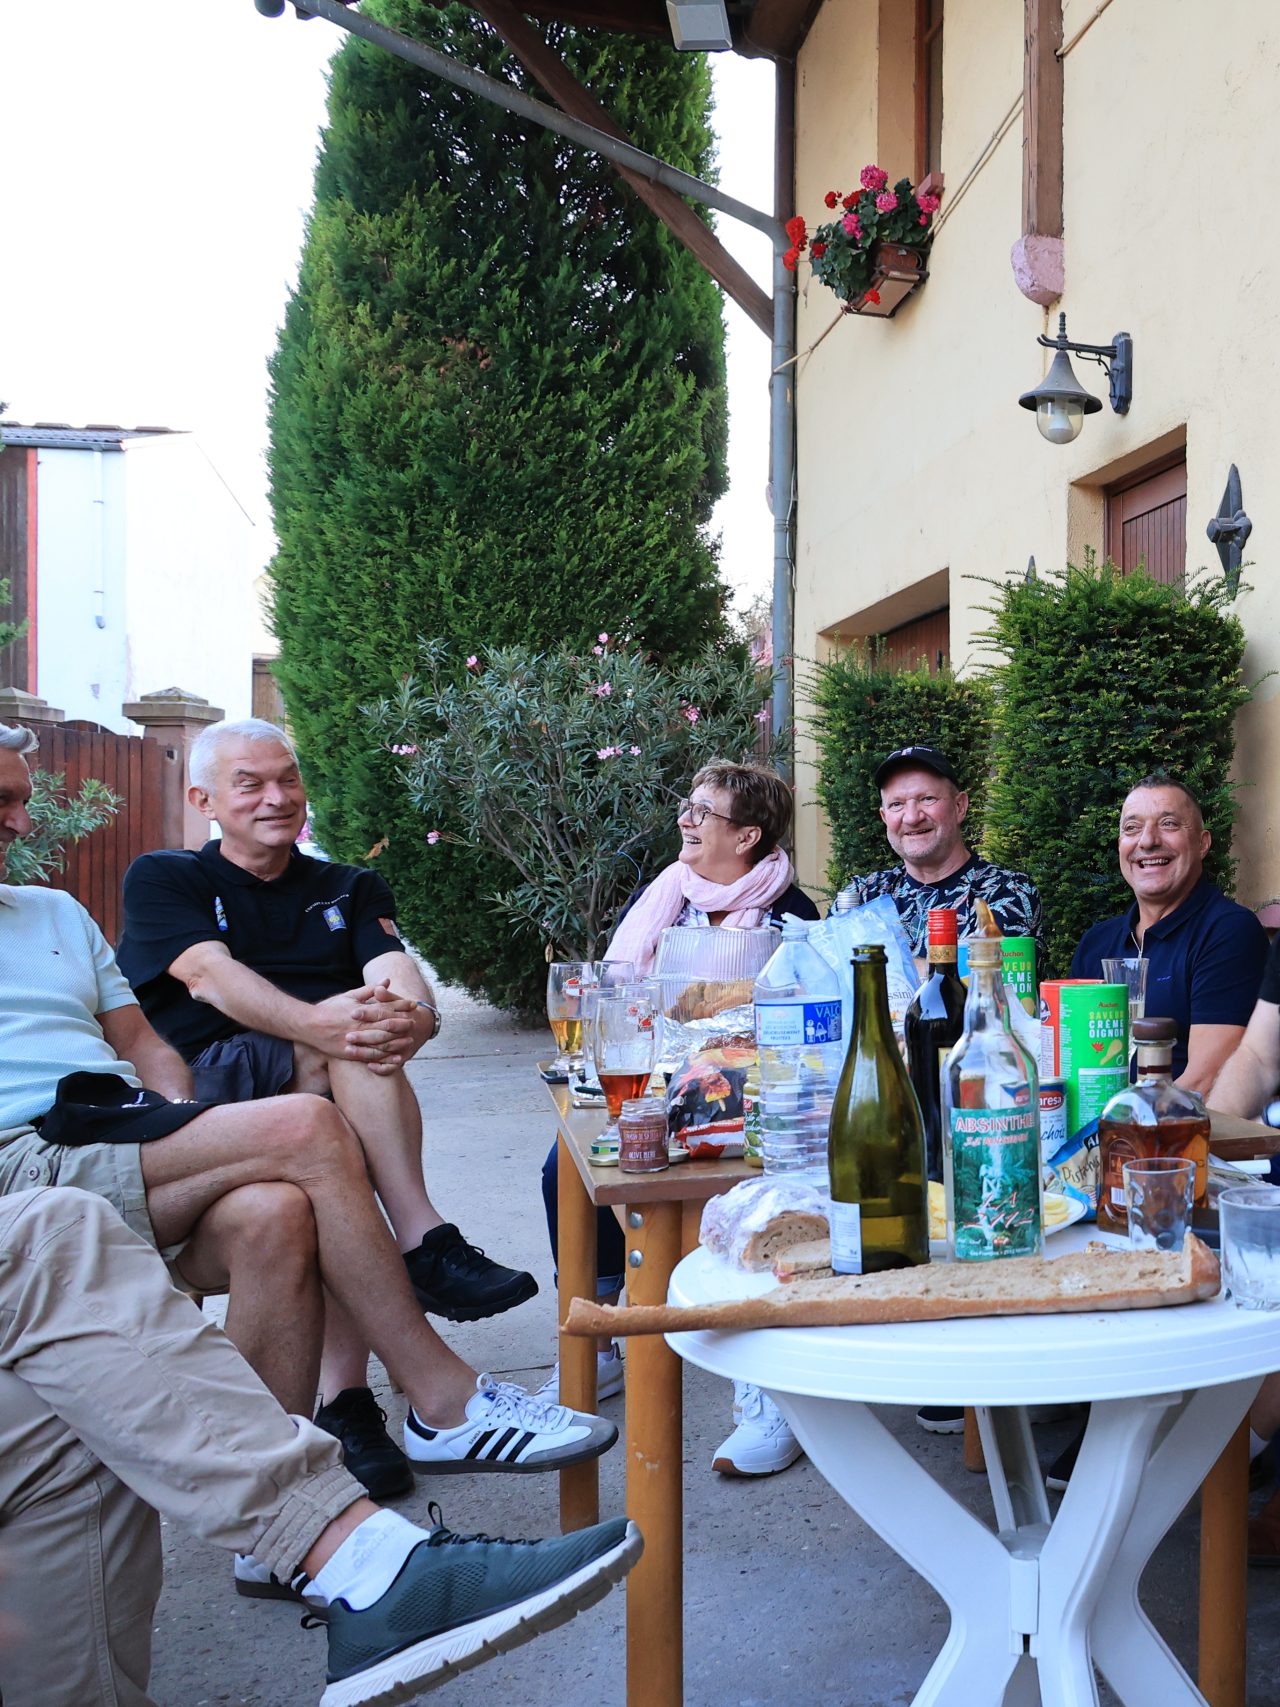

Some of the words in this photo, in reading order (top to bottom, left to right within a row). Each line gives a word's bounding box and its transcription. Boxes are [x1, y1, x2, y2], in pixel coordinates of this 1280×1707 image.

[1088, 1010, 1124, 1020] SAVEUR
[1088, 1018, 1124, 1029] CRÈME
[1088, 1029, 1124, 1038] OIGNON
[955, 1112, 1036, 1133] ABSINTHE
